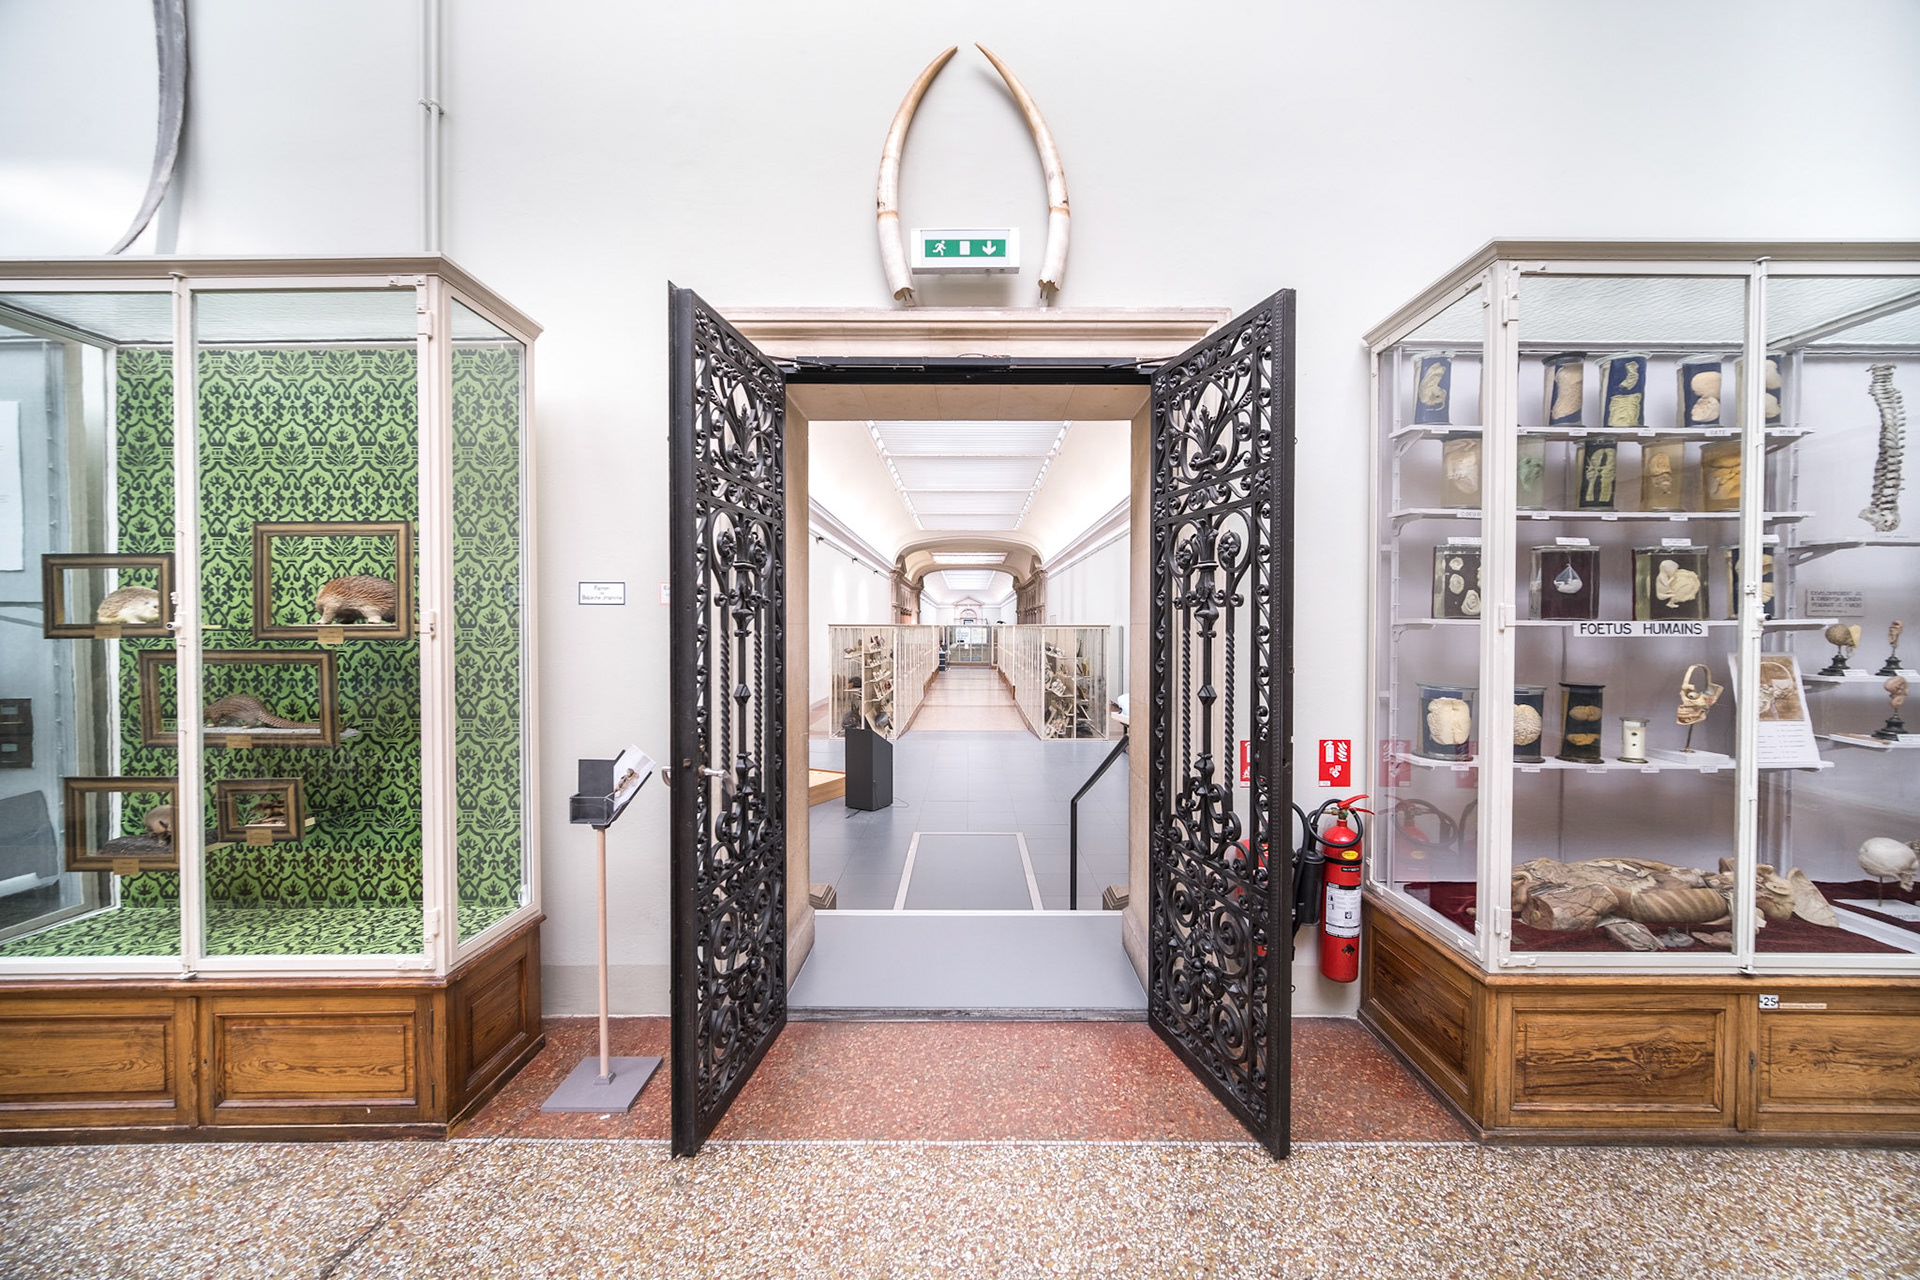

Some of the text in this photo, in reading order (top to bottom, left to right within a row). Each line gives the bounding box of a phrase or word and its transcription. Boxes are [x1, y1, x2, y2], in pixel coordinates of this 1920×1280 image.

[1580, 622, 1703, 635] FOETUS HUMAINS
[1764, 997, 1777, 1006] 25
